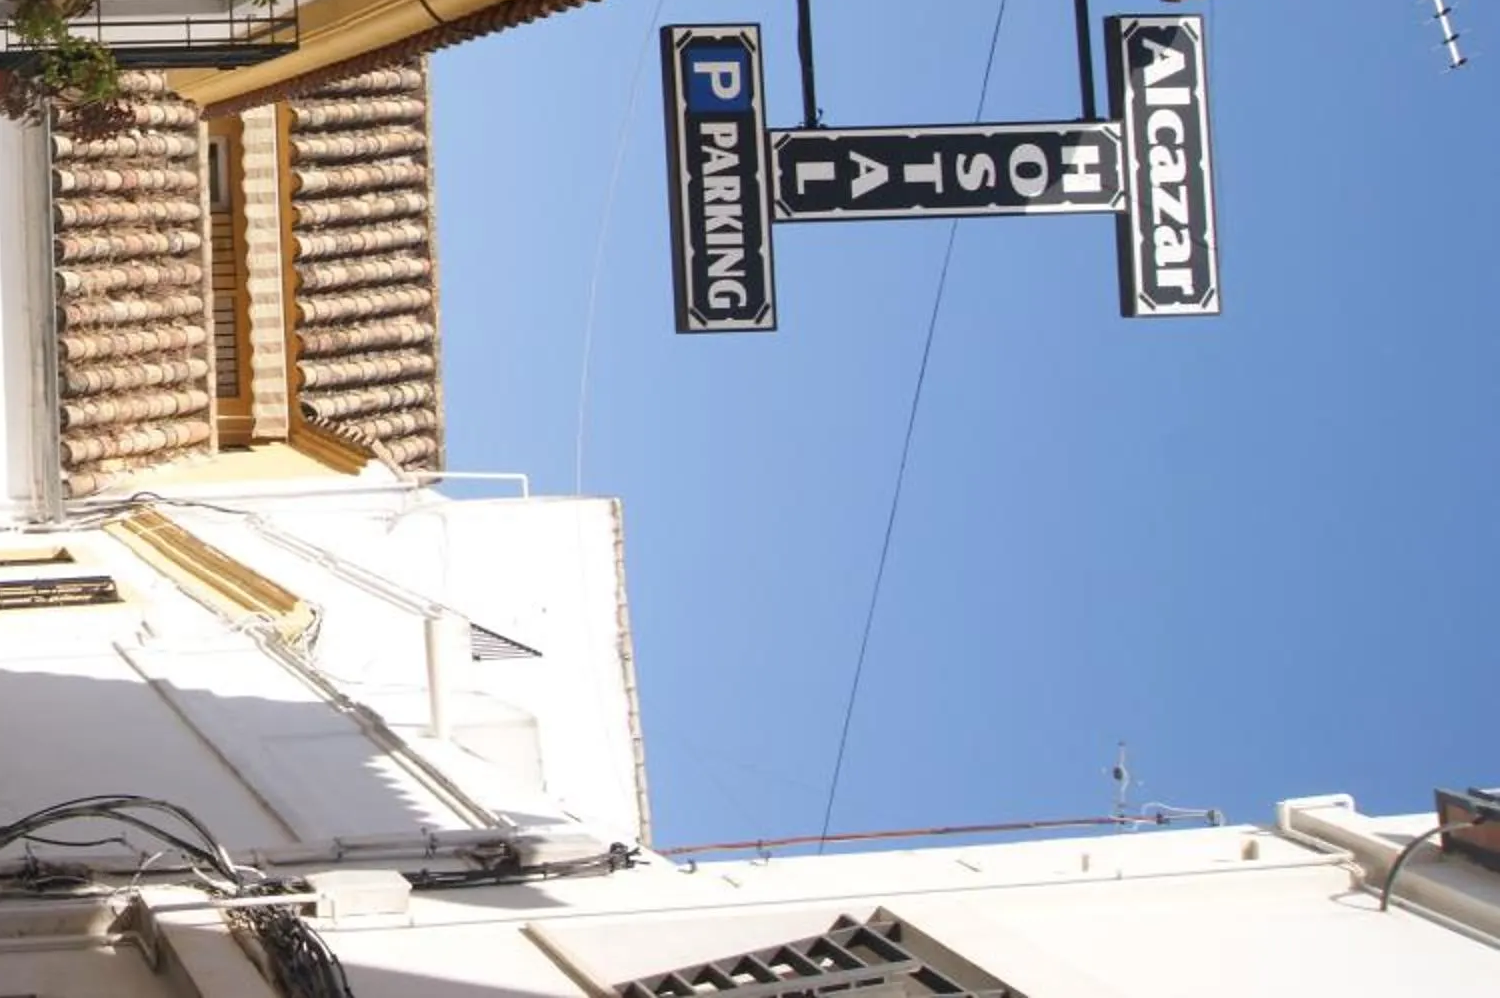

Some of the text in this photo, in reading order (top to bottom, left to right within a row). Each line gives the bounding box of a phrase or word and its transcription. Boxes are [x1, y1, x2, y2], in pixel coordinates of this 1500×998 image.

[692, 61, 747, 310] P PARKING
[794, 142, 1102, 200] HOSTAL
[1141, 38, 1195, 297] Alcazar
